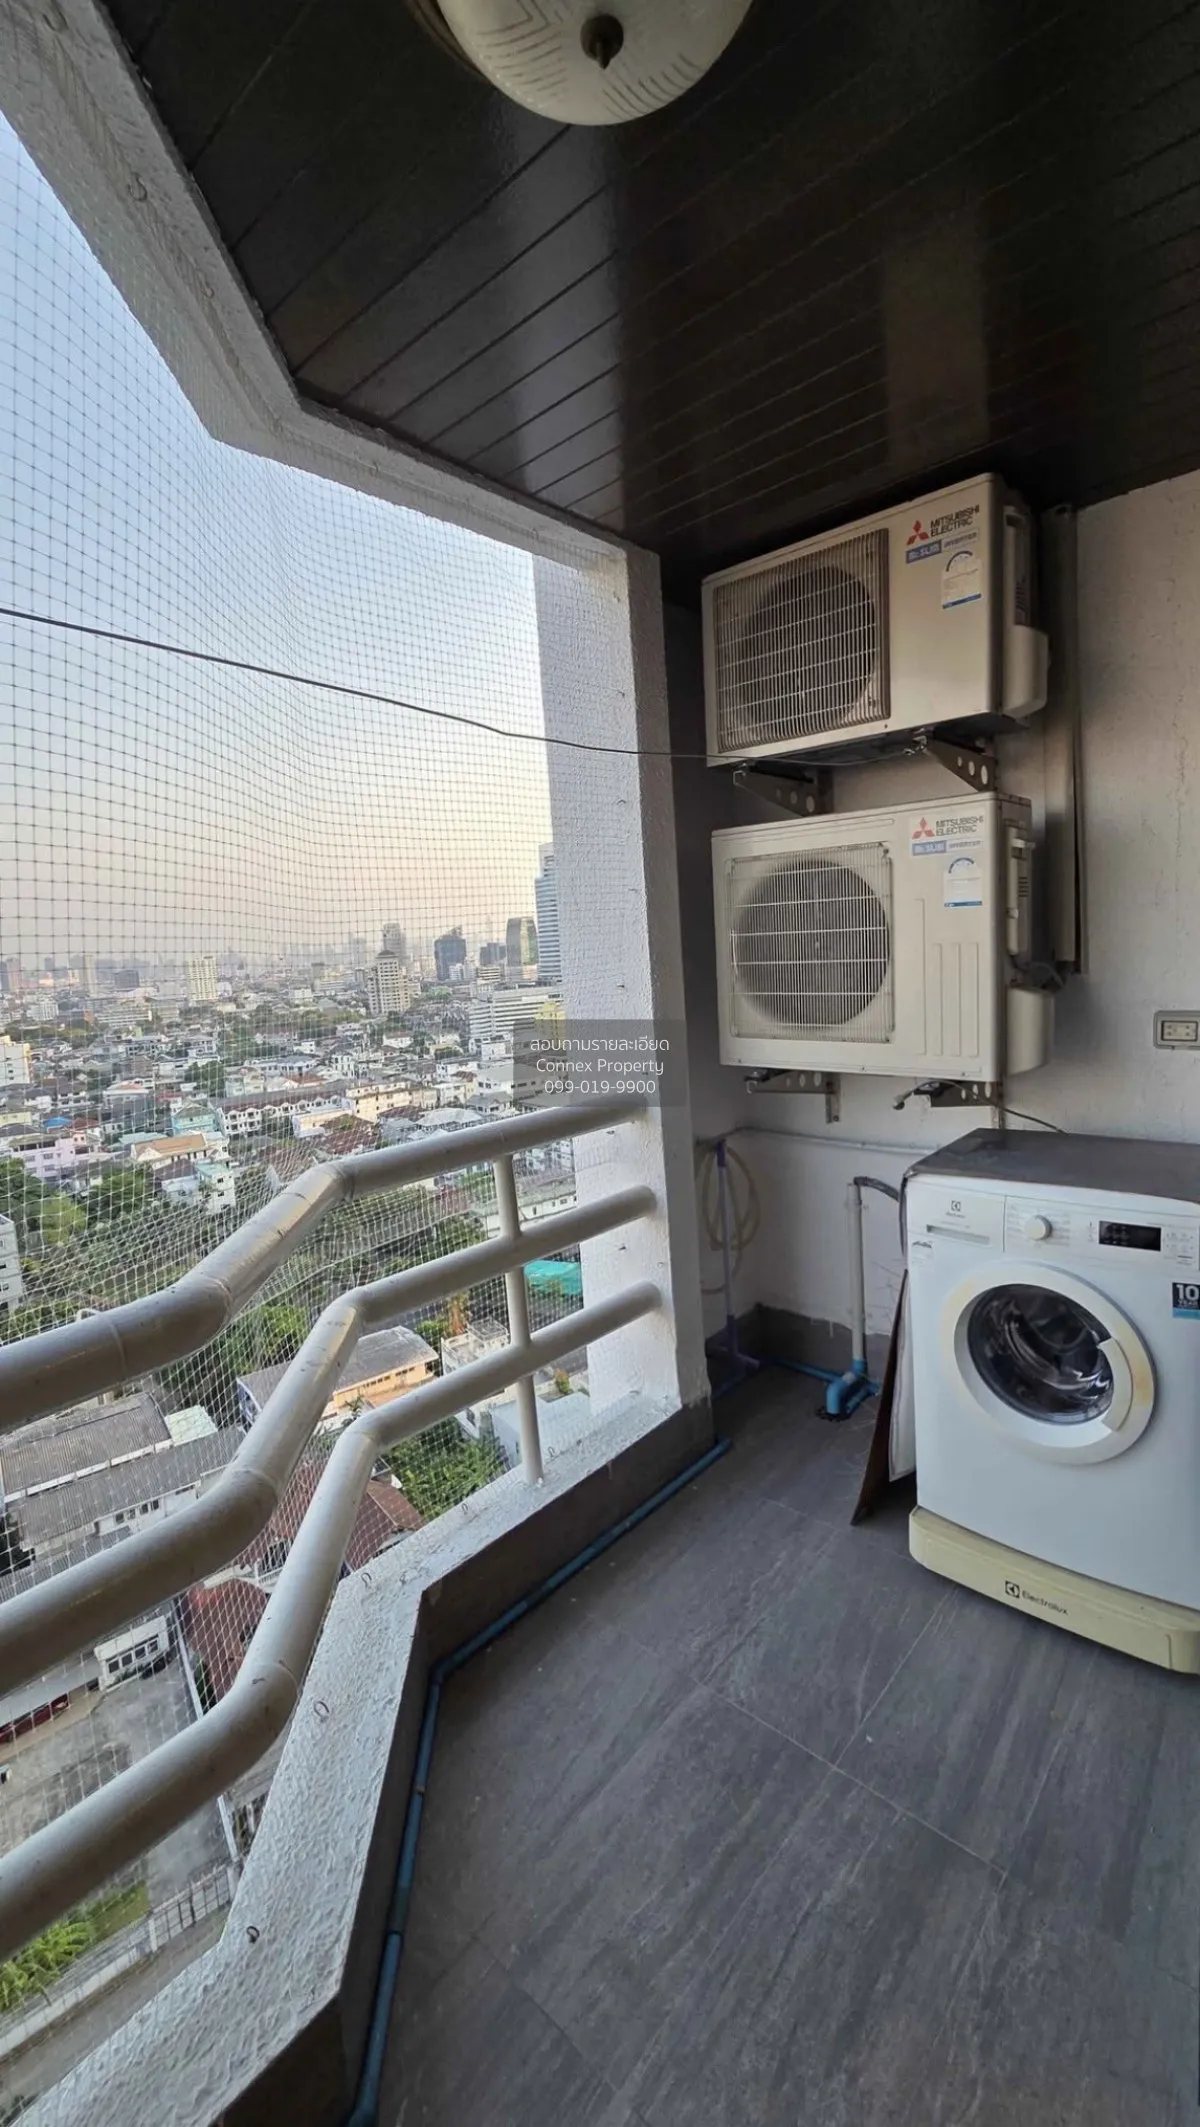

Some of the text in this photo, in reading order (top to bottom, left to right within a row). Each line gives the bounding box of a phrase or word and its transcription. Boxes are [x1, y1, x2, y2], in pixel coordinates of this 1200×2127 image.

[930, 504, 980, 529] MITSUBISHI
[930, 516, 973, 537] ELECTRIC
[935, 815, 984, 828] MITSUBISHI
[936, 824, 978, 837] ELECTRIC
[1176, 1284, 1200, 1301] 10
[1022, 1590, 1069, 1616] Electrolux
